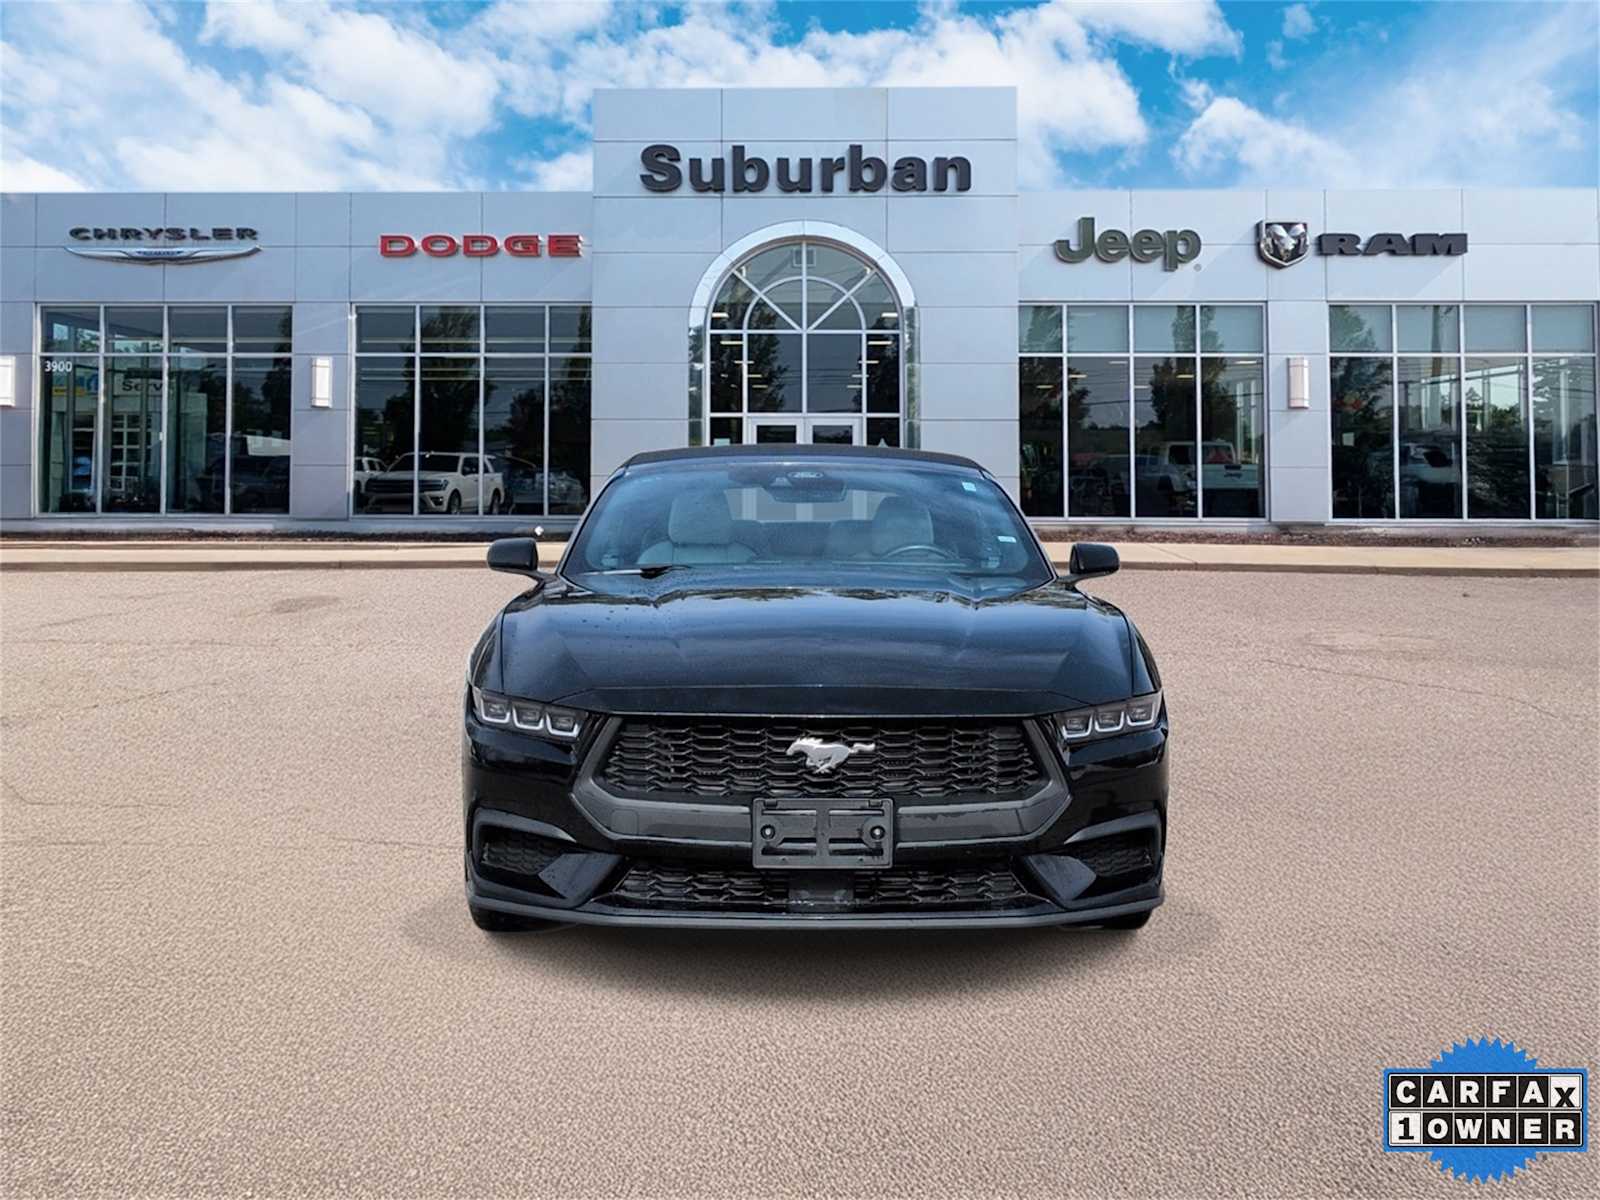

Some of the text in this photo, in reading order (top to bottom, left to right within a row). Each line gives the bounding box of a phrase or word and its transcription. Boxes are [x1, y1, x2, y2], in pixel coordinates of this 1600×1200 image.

[640, 144, 972, 192] Suburban
[69, 227, 258, 240] CHRYSLER
[1054, 217, 1201, 272] Jeep
[1317, 233, 1468, 256] RAM
[380, 235, 583, 257] DODGE
[44, 360, 73, 372] 3900
